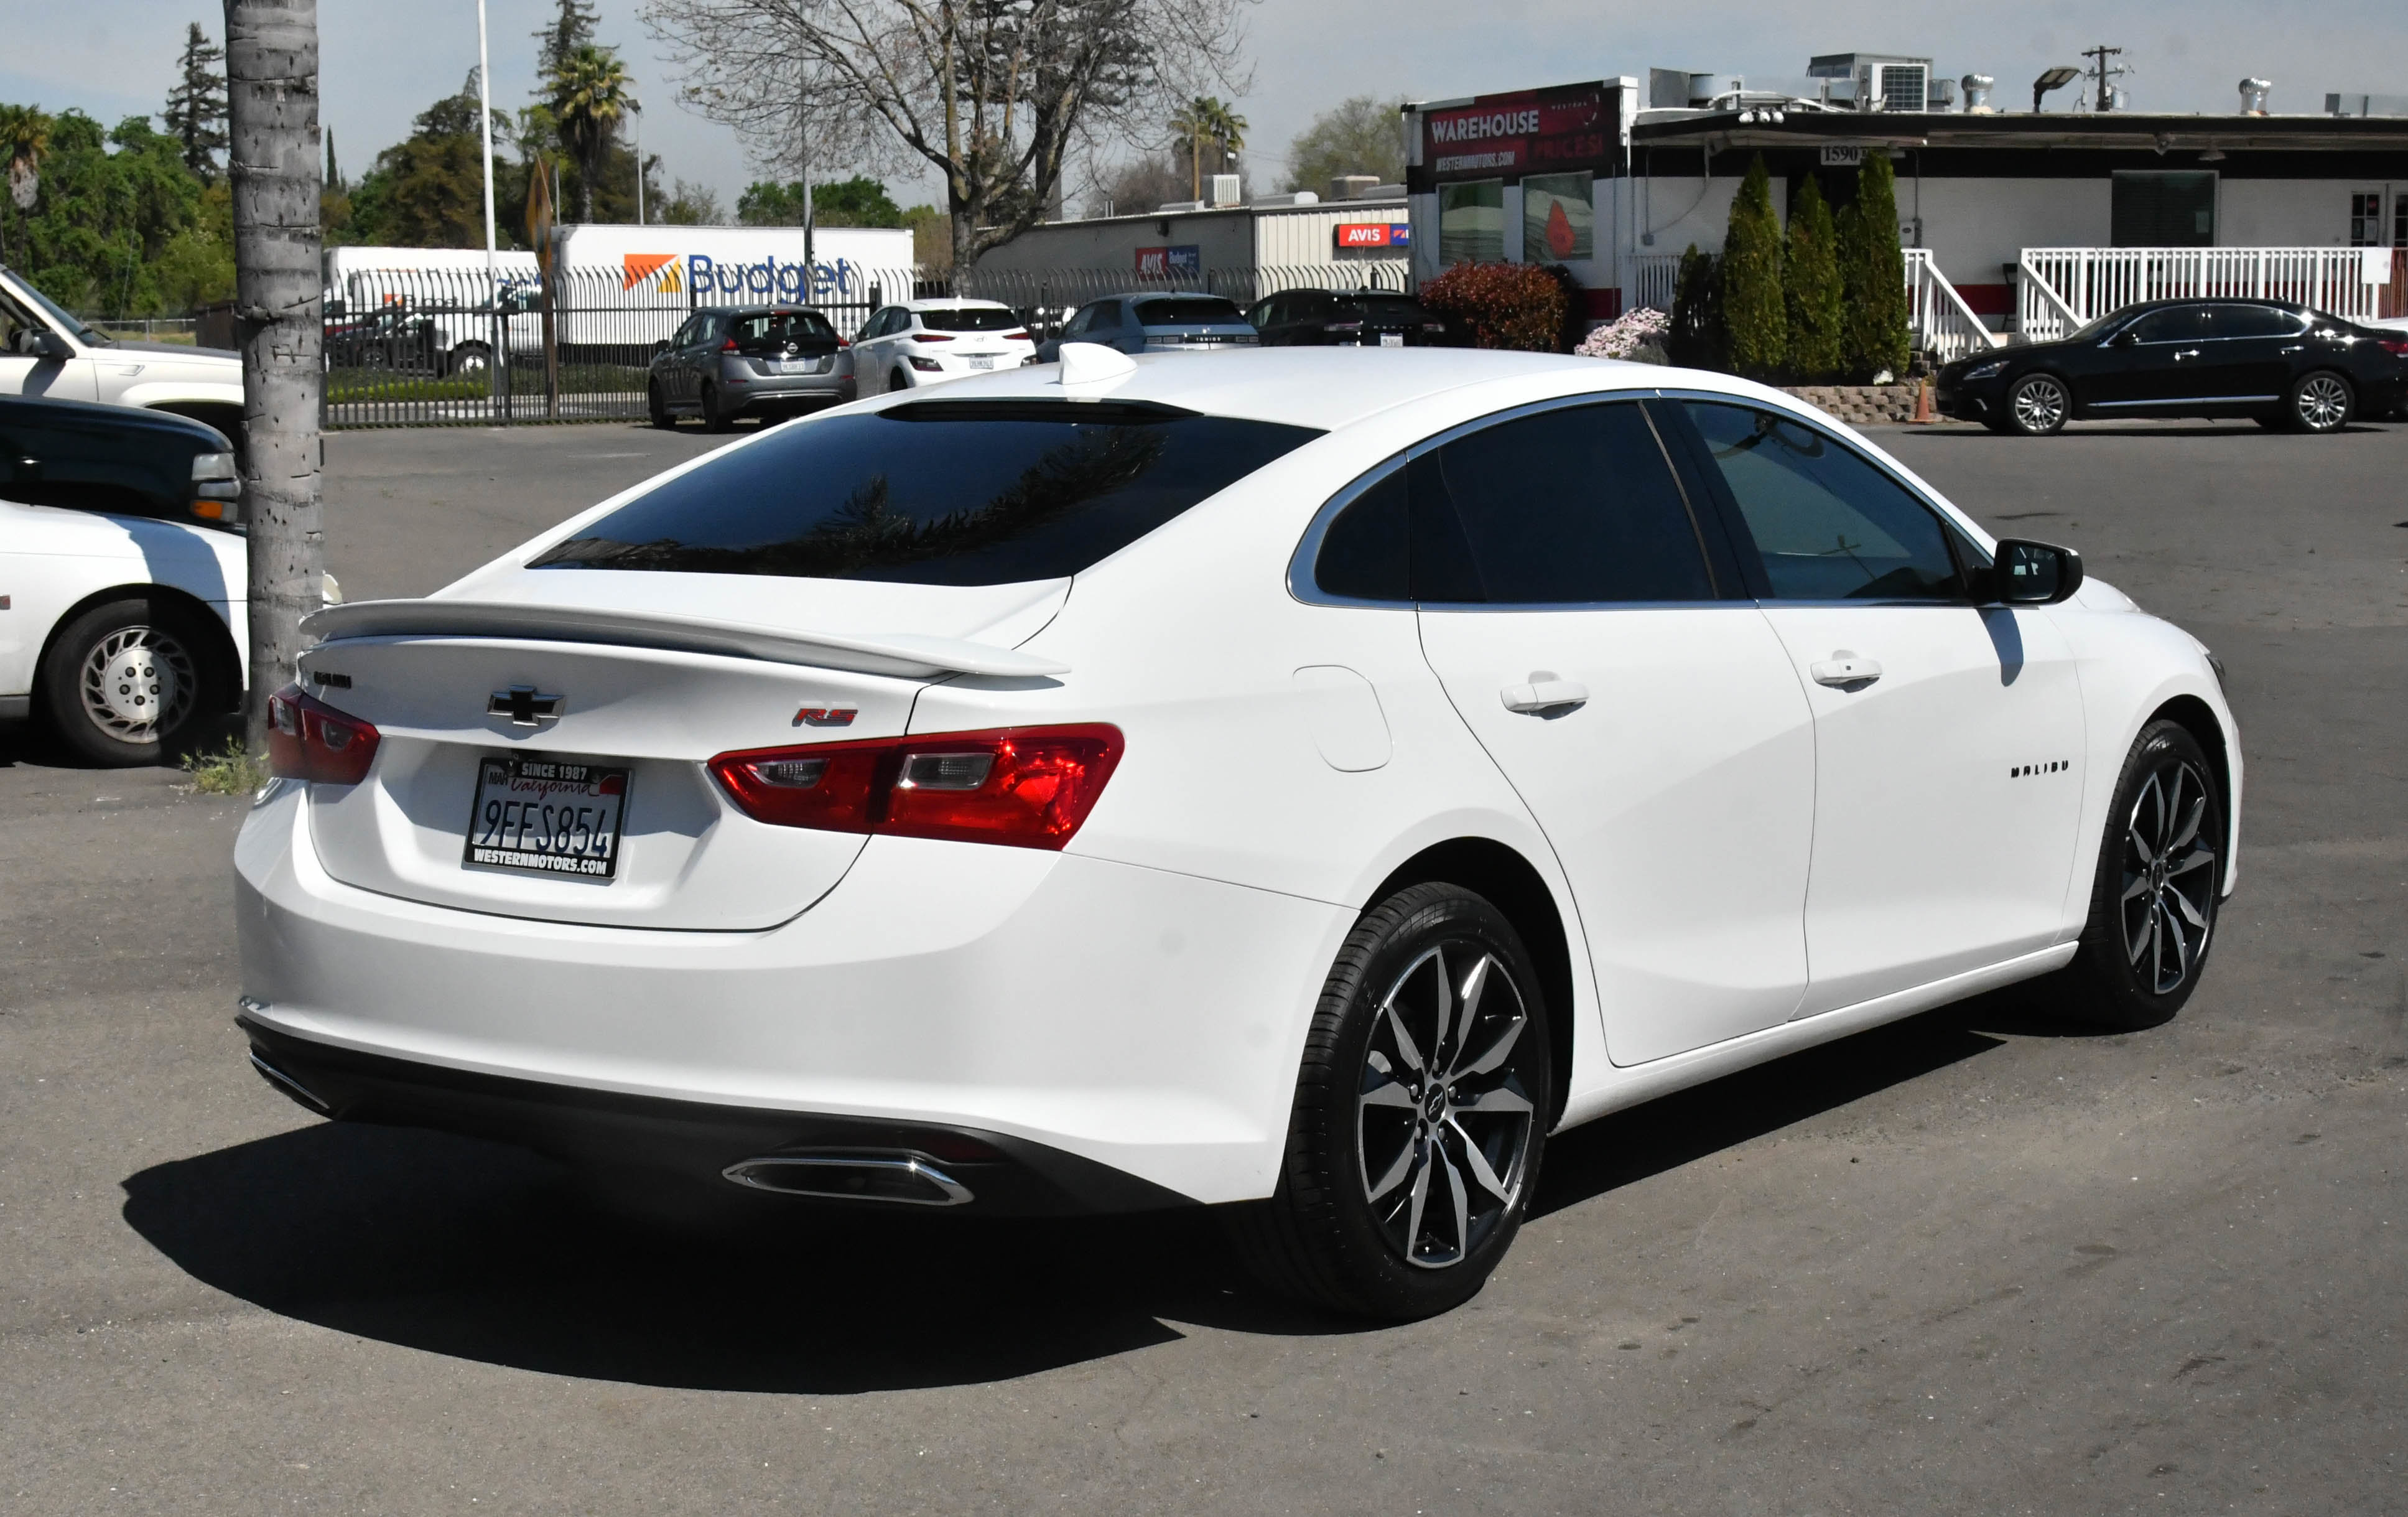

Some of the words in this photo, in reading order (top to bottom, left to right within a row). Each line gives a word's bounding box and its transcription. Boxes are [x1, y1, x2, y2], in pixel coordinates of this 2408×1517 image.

[1431, 109, 1540, 144] WAREHOUSE
[1822, 145, 1858, 161] 1590
[1348, 228, 1380, 242] AVIS
[1140, 253, 1163, 274] AVIS
[689, 254, 850, 304] Budget
[792, 708, 858, 727] RS
[521, 762, 556, 778] SINCE
[559, 766, 587, 780] 1987
[2011, 760, 2069, 778] MALIBU
[511, 777, 600, 800] California
[480, 799, 608, 858] 9FFS854
[474, 848, 607, 875] WESTERNMOTORS.COM
